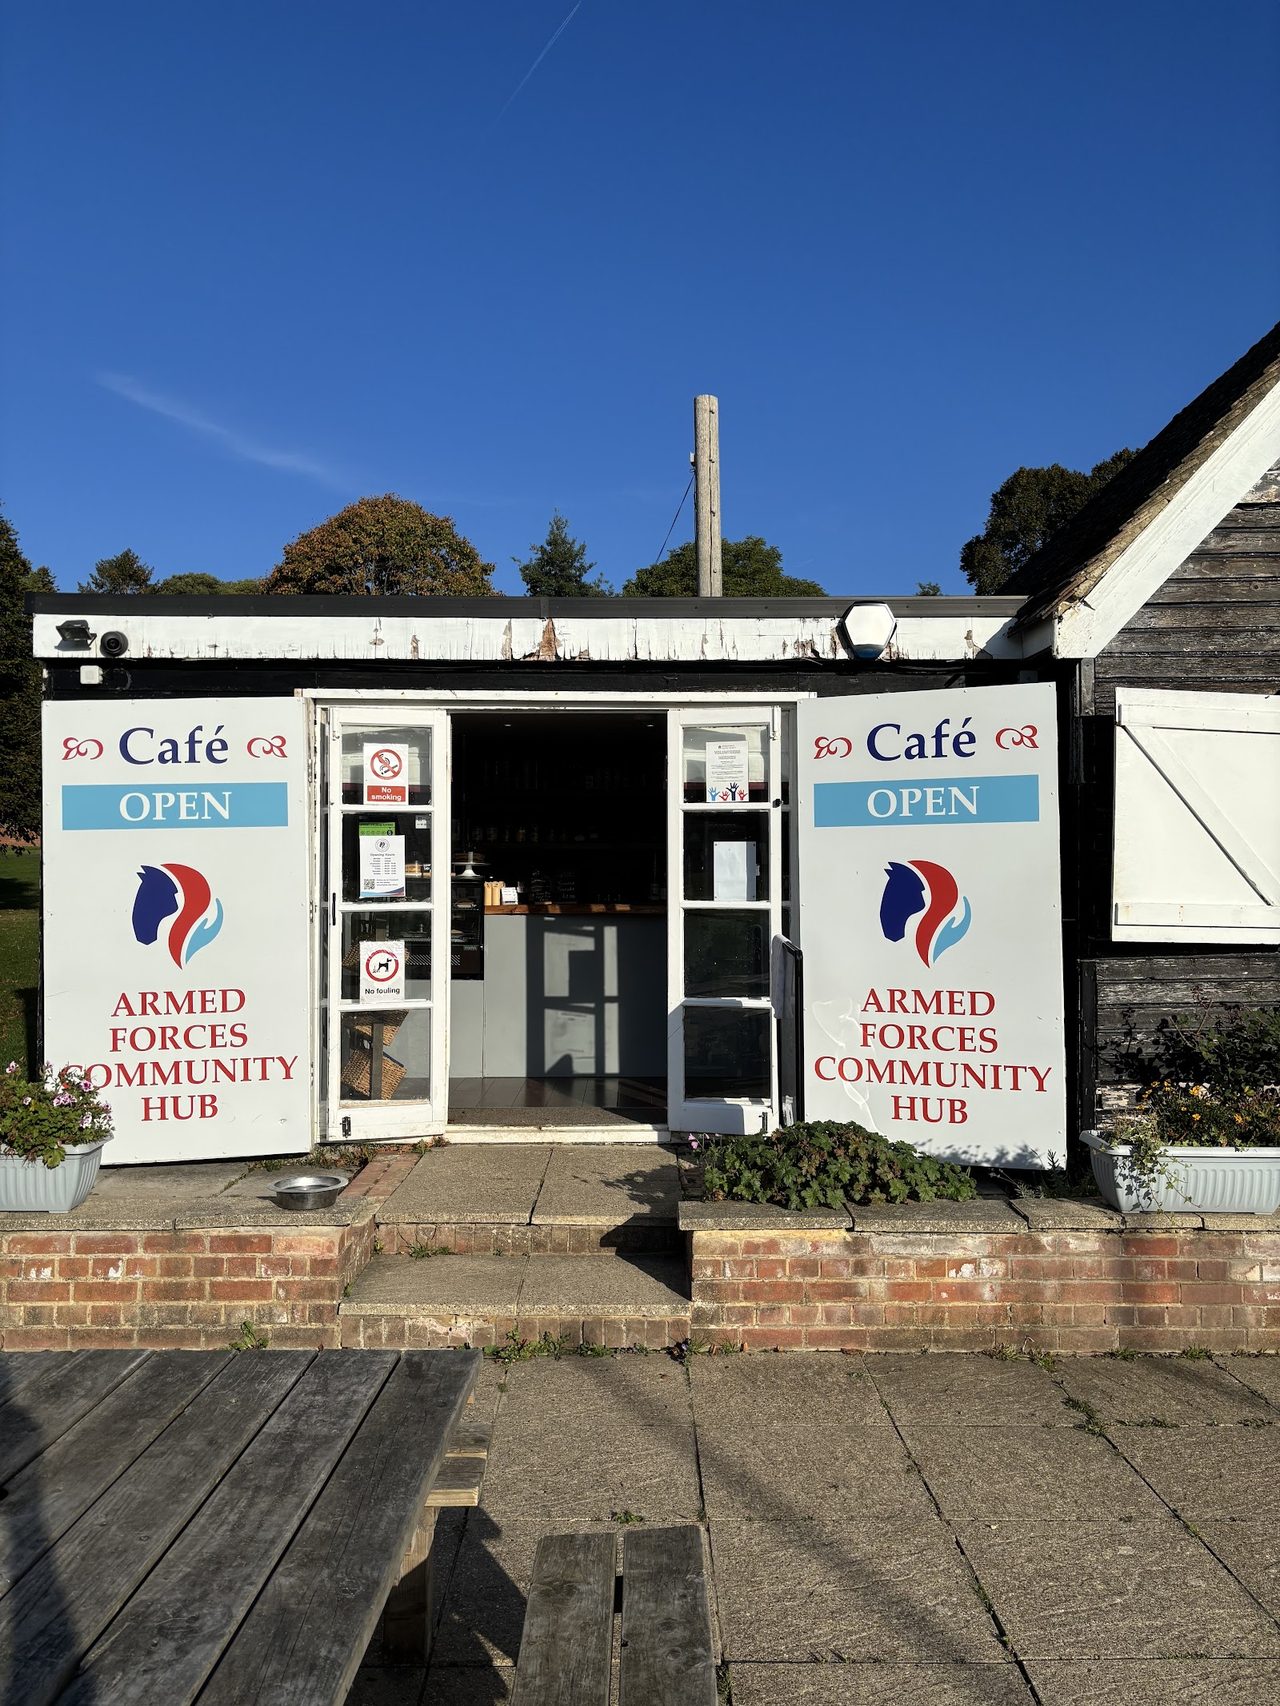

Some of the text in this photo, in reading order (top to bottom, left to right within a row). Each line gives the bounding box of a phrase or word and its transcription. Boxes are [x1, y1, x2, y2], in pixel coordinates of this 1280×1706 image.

[119, 725, 229, 765] Café
[866, 717, 976, 762] Café
[119, 791, 232, 821] OPEN
[867, 785, 980, 818] OPEN
[111, 988, 246, 1017] ARMED
[376, 987, 400, 995] fouling
[862, 988, 996, 1016] ARMED
[109, 1023, 248, 1052] FORCES
[860, 1023, 998, 1053] FORCES
[814, 1056, 1052, 1093] COMMUNITY
[141, 1094, 218, 1121] HUB
[892, 1095, 968, 1125] HUB
